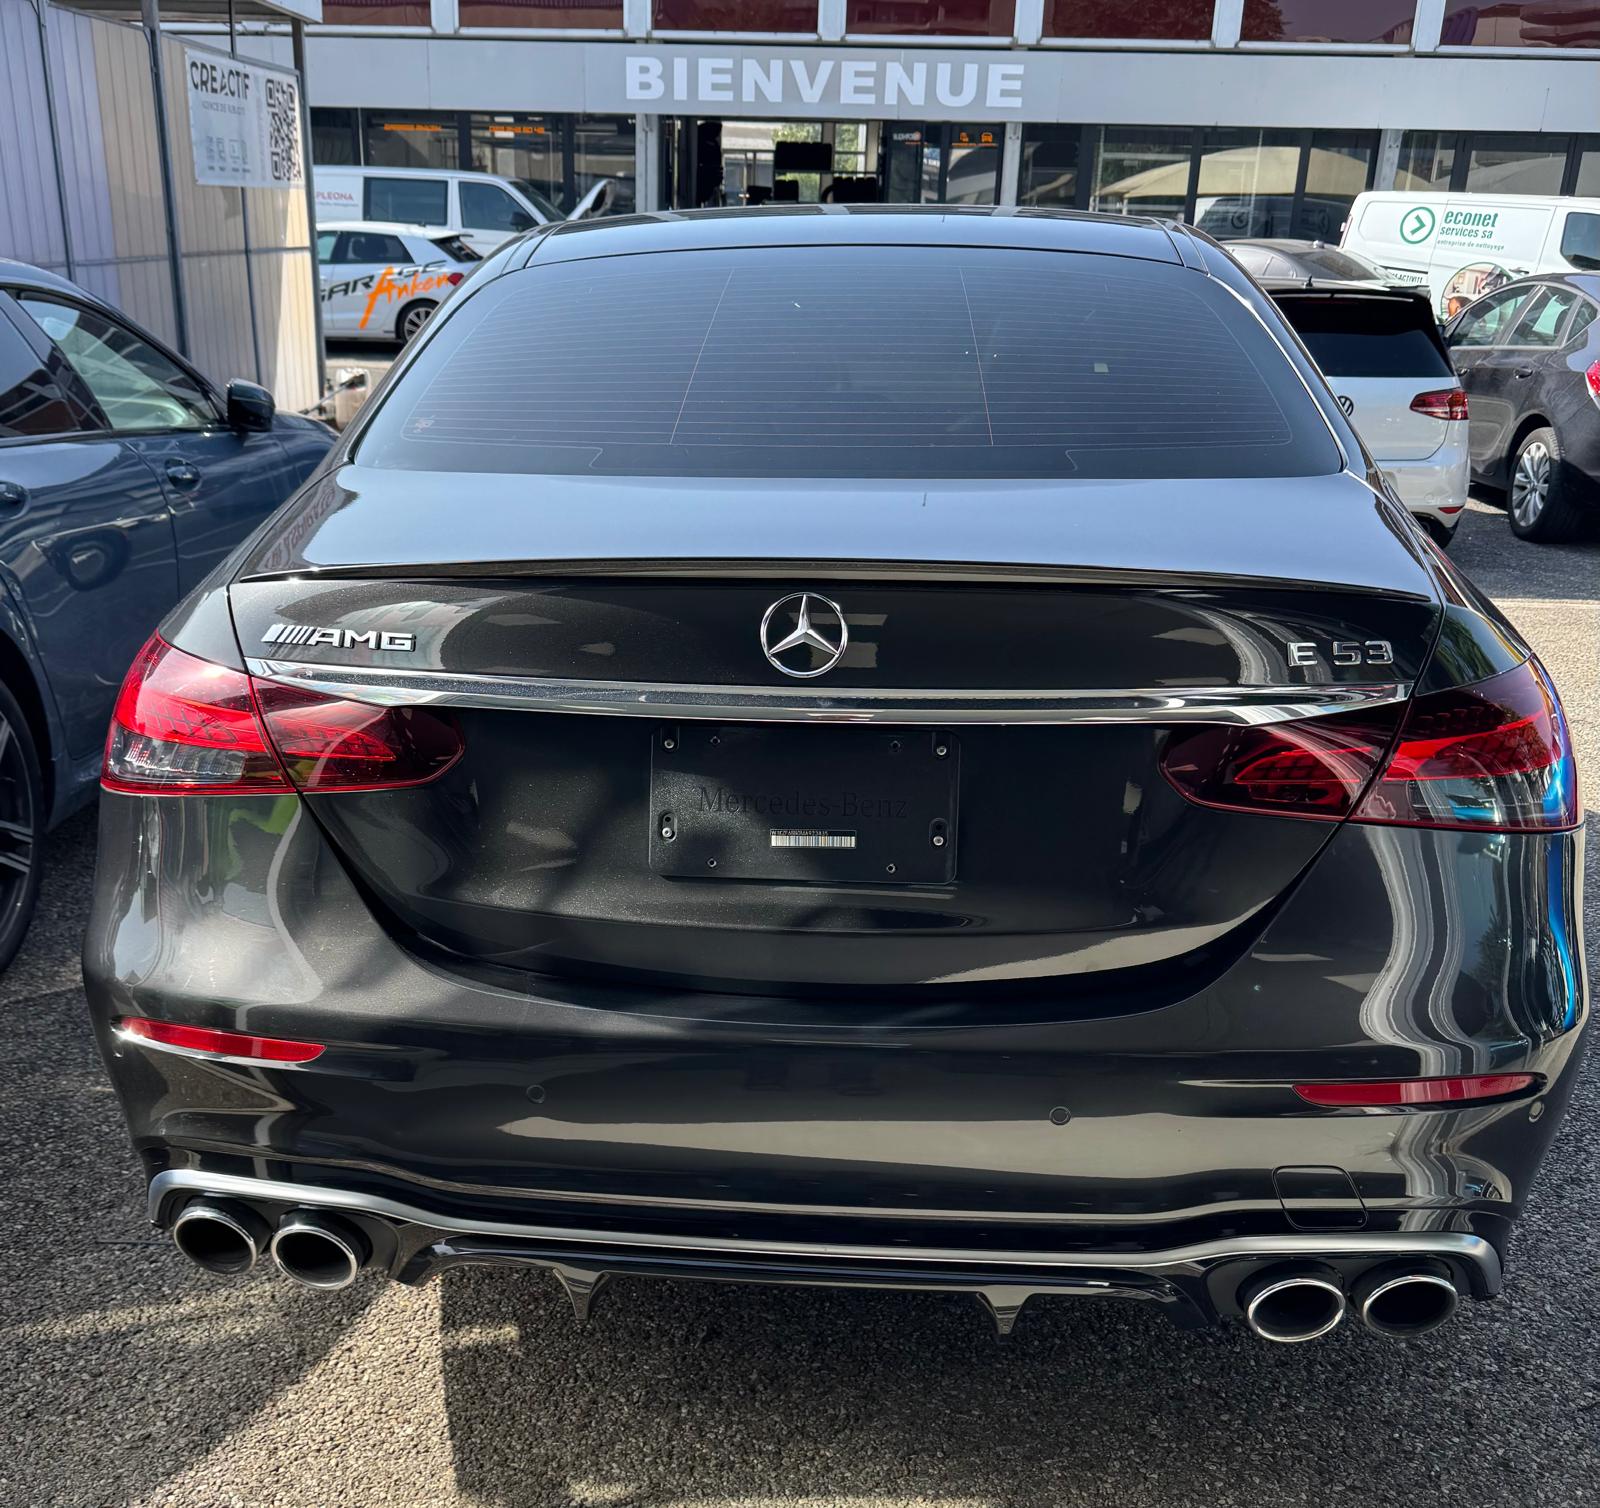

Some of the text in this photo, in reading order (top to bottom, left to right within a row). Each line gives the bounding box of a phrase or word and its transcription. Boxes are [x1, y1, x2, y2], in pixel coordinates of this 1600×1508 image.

[625, 56, 1025, 108] BIENVENUE
[1444, 210, 1499, 228] econet
[1440, 226, 1493, 239] services sa
[308, 627, 416, 652] AMG
[1287, 640, 1394, 667] E 53
[699, 786, 908, 819] Mercedes-Benz
